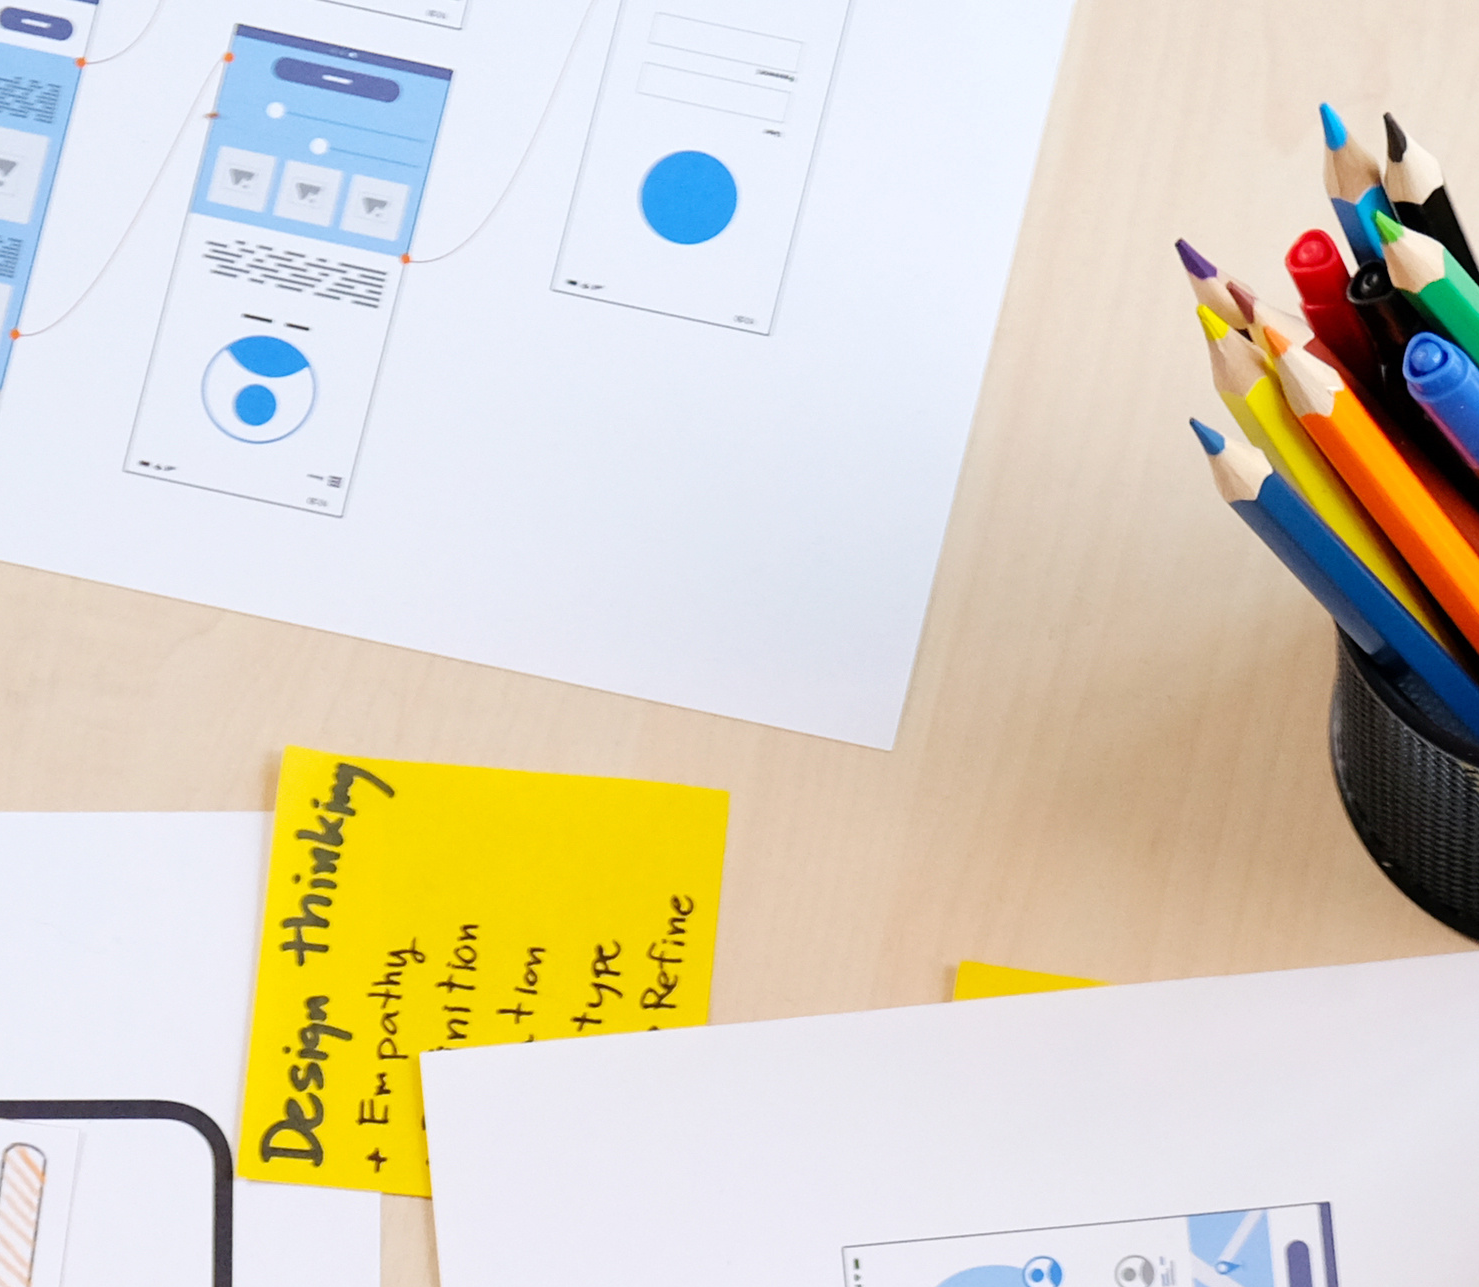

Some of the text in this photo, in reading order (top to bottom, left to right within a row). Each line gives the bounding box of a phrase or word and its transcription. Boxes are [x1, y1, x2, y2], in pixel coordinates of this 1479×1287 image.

[260, 761, 397, 1168] Design thinking
[497, 946, 548, 1045] tion
[639, 894, 695, 1011] Refine
[358, 936, 428, 1126] Empathy
